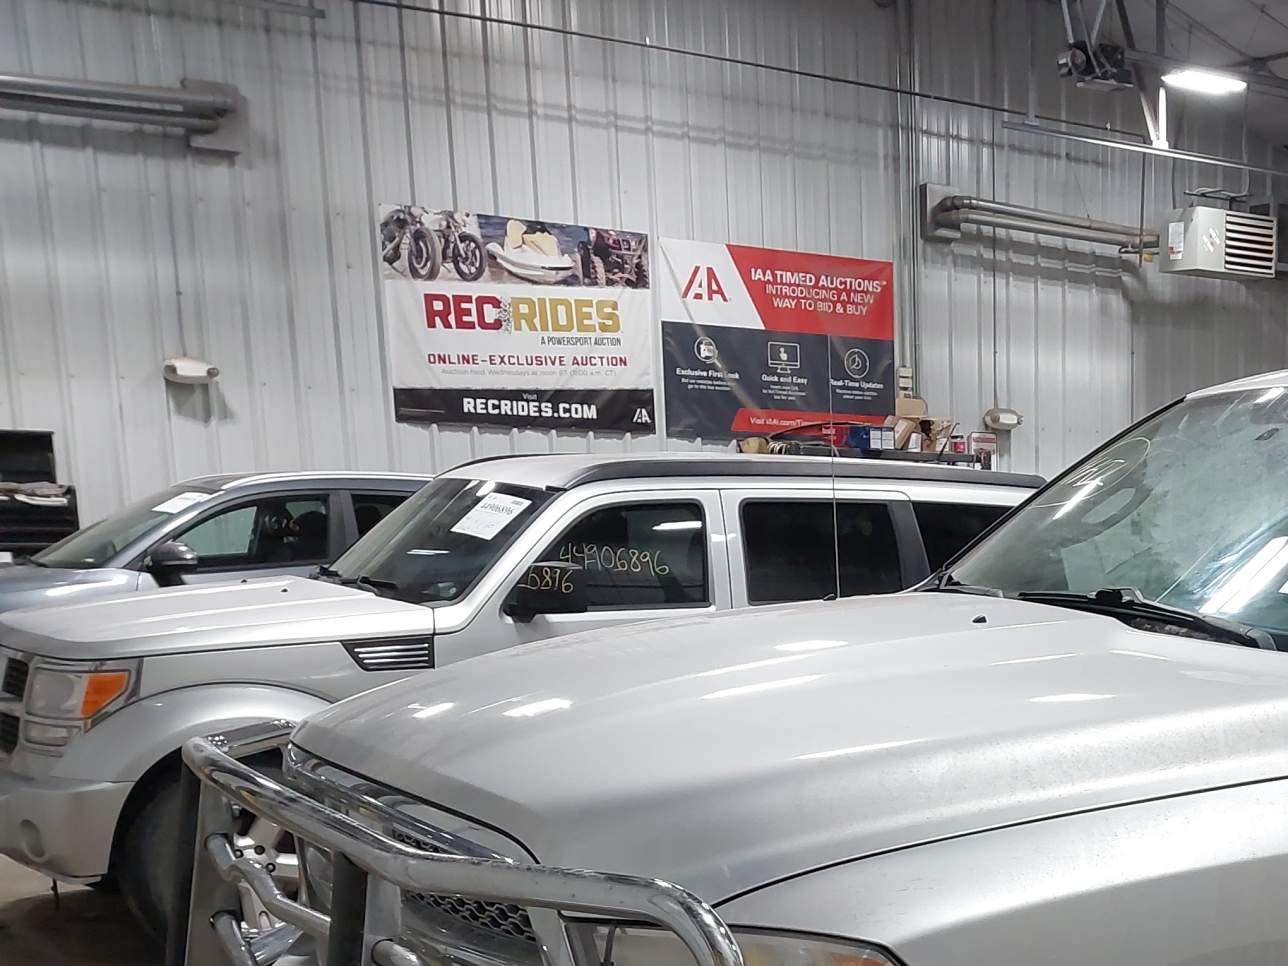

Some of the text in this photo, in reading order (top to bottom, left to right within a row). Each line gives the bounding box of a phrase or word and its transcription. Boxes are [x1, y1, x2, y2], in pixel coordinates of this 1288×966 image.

[751, 268, 773, 282] IAA
[774, 270, 816, 286] TIMED
[766, 284, 874, 304] INTRODUCING A NEW
[772, 297, 868, 315] WAY TO BID & BUY
[540, 336, 621, 347] A POWERSPORT AUCTION
[428, 353, 628, 367] ONLINE-EXCLUSIVE AUCTION
[676, 367, 707, 377] Exclusive
[761, 374, 808, 385] Quick and Easy
[463, 397, 597, 420] RECRIDES.COM
[560, 542, 670, 576] 44906896
